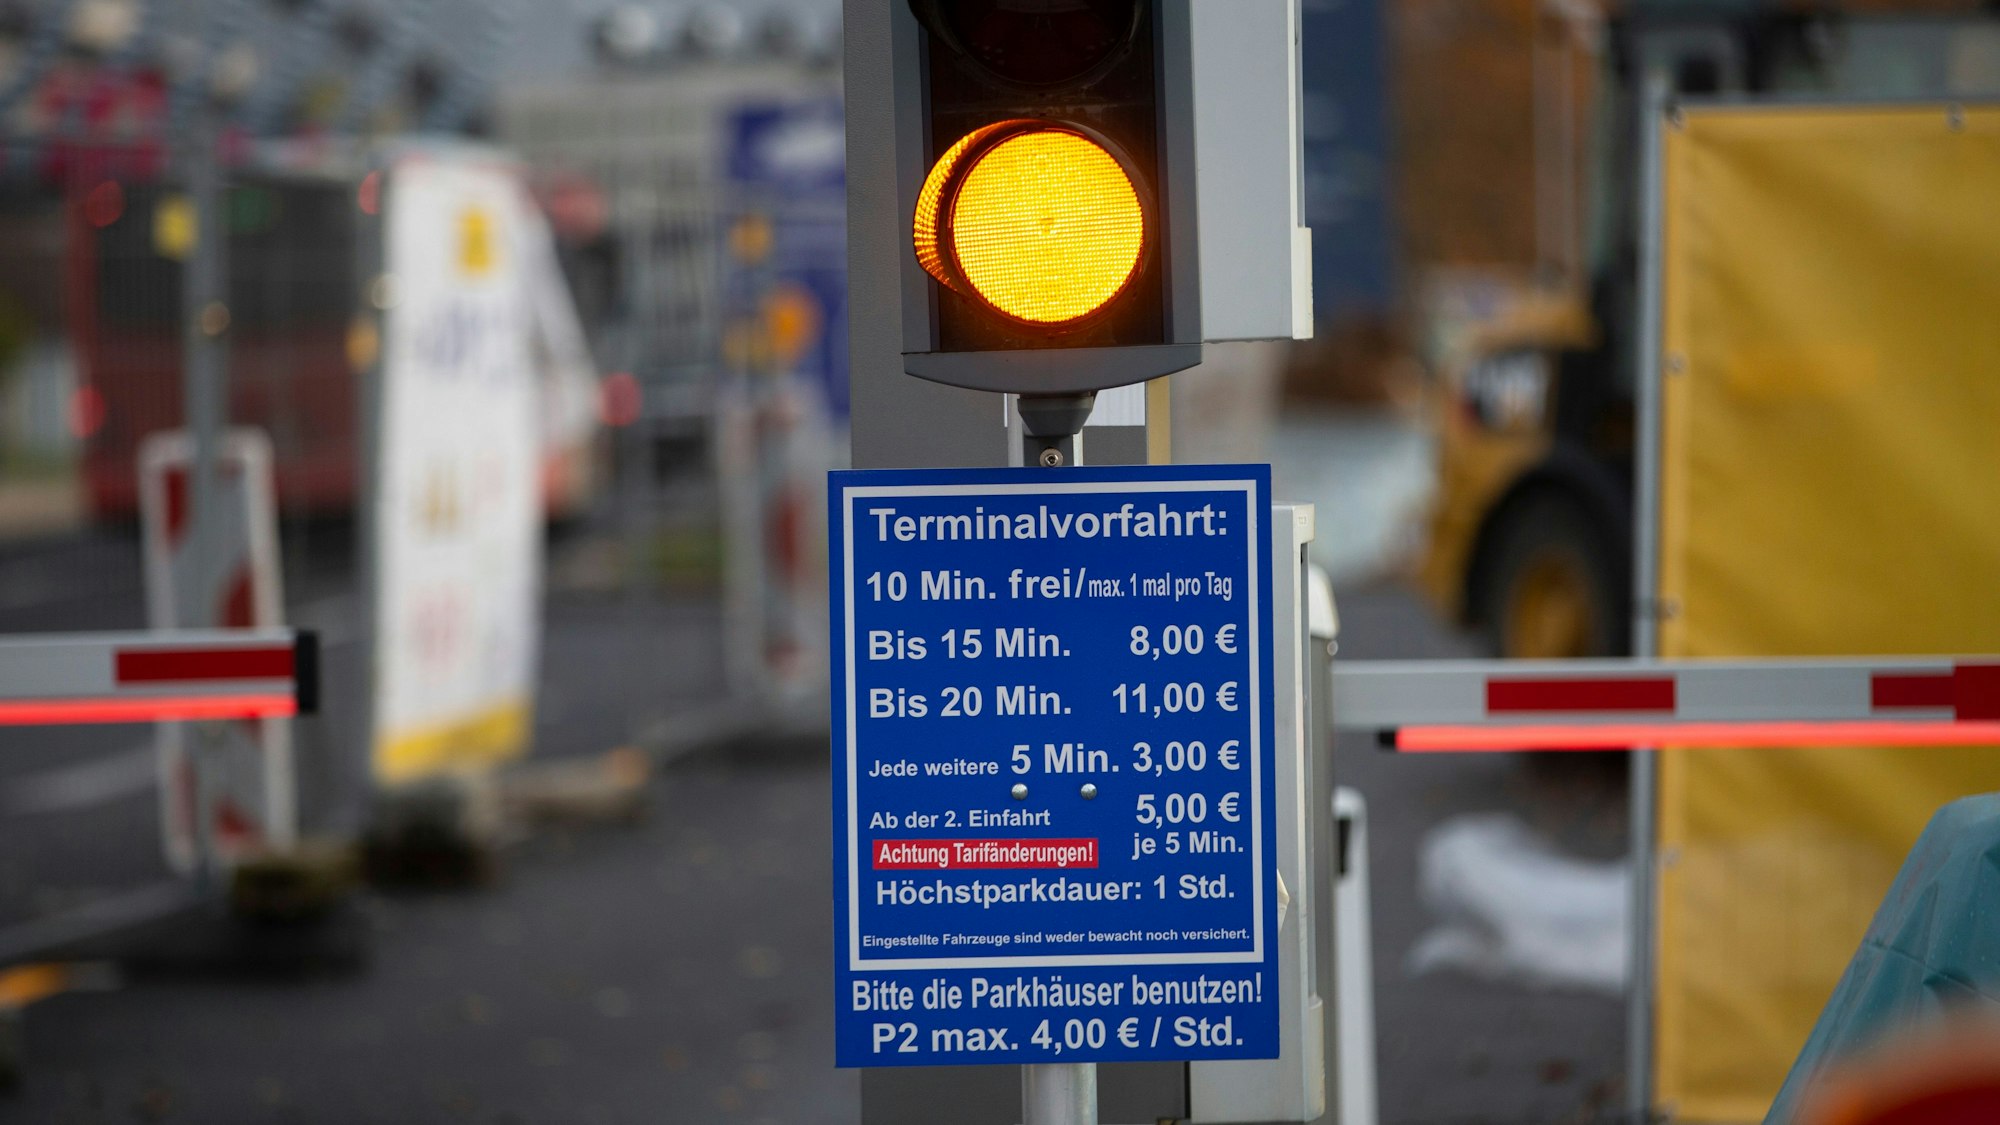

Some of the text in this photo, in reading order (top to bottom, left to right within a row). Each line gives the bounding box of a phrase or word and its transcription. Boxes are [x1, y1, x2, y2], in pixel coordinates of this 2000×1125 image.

[870, 504, 1226, 541] Terminalvorfahrt:
[867, 572, 907, 601] 10
[922, 571, 995, 600] Min.
[1130, 573, 1136, 596] 1
[1143, 573, 1170, 596] mal
[1176, 578, 1200, 601] pro
[1205, 572, 1232, 601] Tag
[869, 624, 1237, 660] Bis 15 Min. 8,00 €
[870, 682, 1238, 718] Bis 20 Min. 11,00 €
[869, 740, 1239, 777] Jede weitere 5 Min. 3,00 €
[870, 809, 1050, 828] Ab der 2. Einfahrt
[1136, 792, 1240, 829] 5,00 €
[880, 842, 1092, 867] Achtung Tarifänderungen!
[1132, 831, 1243, 860] je 5 Min.
[877, 874, 1234, 908] Höchstparkdauer: 1 Std.
[863, 928, 1249, 949] Eingestellte Fahrzeuge sind weder bewacht noch versichert.
[853, 972, 1261, 1010] Bitte die Parkhäuser benutzen!
[874, 1016, 1242, 1055] P2 max. 4,00 € / Std.
